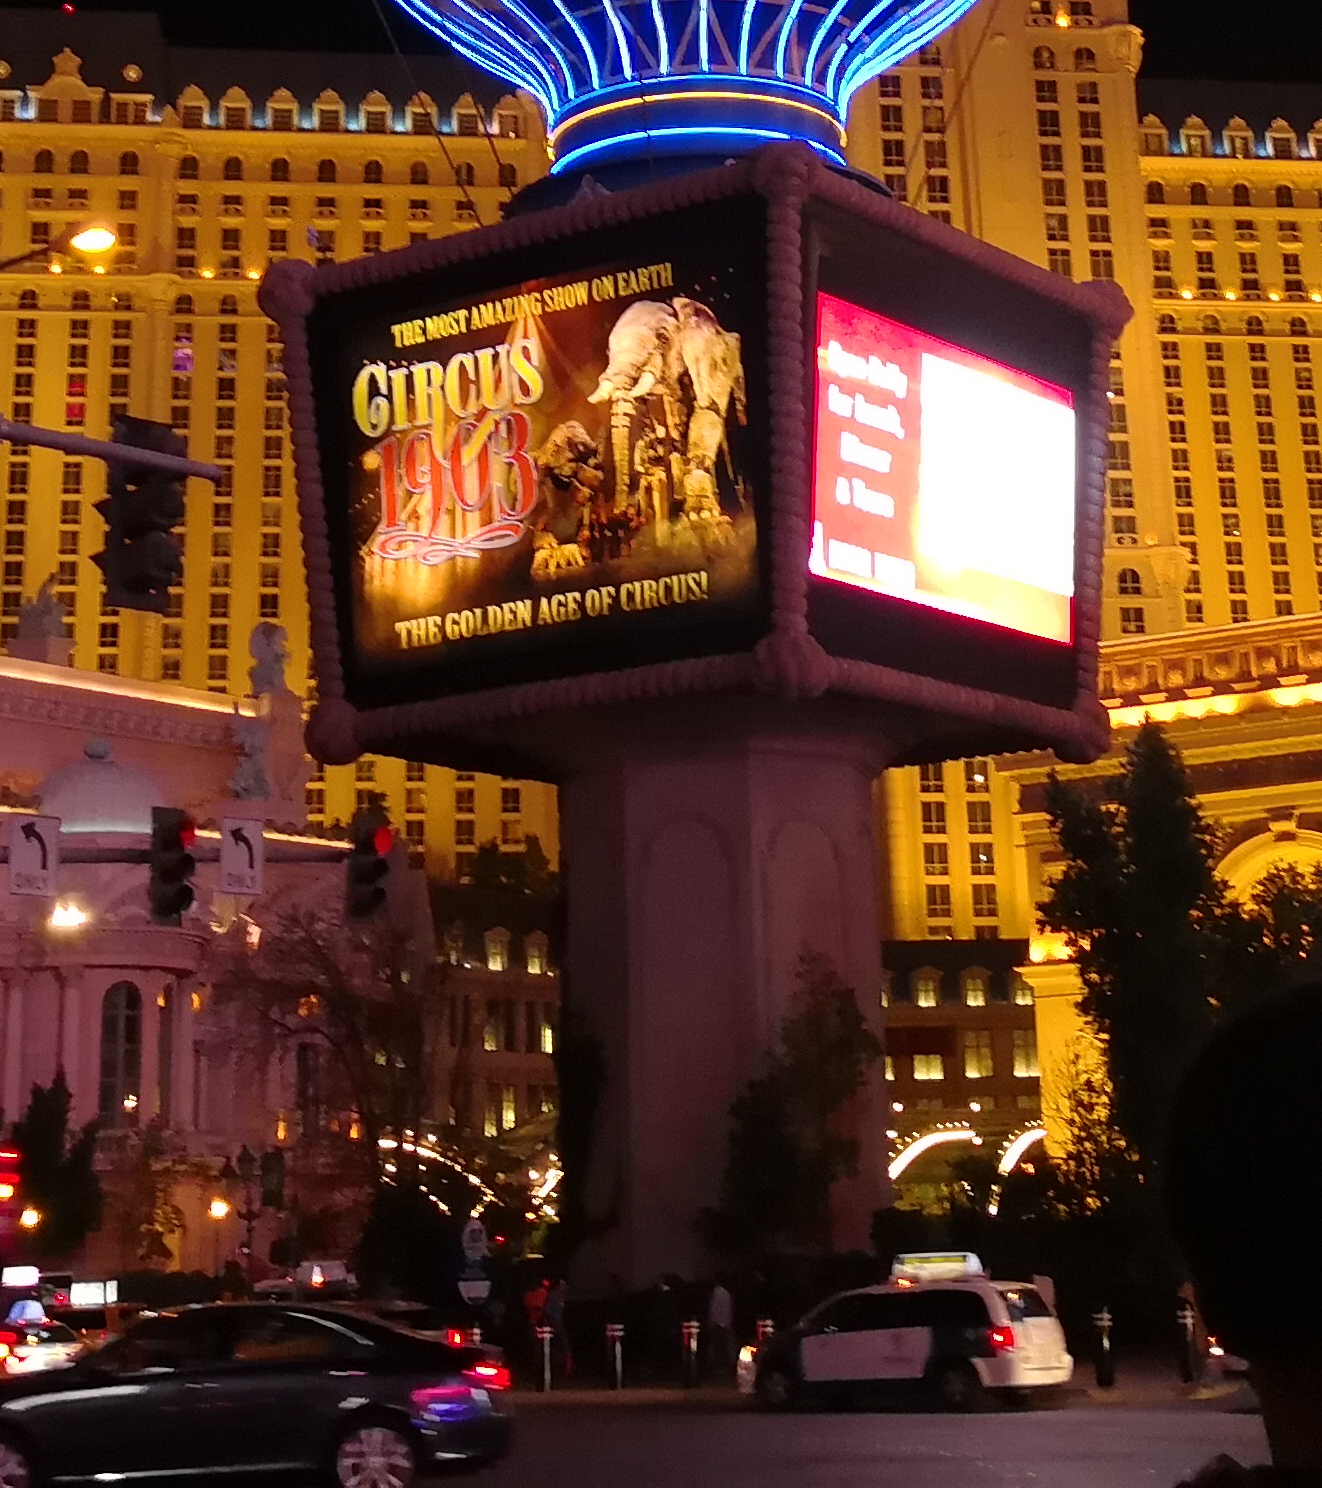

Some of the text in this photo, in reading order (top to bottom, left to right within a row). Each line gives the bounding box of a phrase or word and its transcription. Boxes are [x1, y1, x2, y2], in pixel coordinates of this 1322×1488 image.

[391, 262, 674, 348] THE MOST AMAZING SHOW ON EARTH
[352, 338, 544, 449] CIRCUS
[376, 410, 539, 536] 1903
[394, 570, 710, 650] THE GOLDEN AGE OF CIRCUS!
